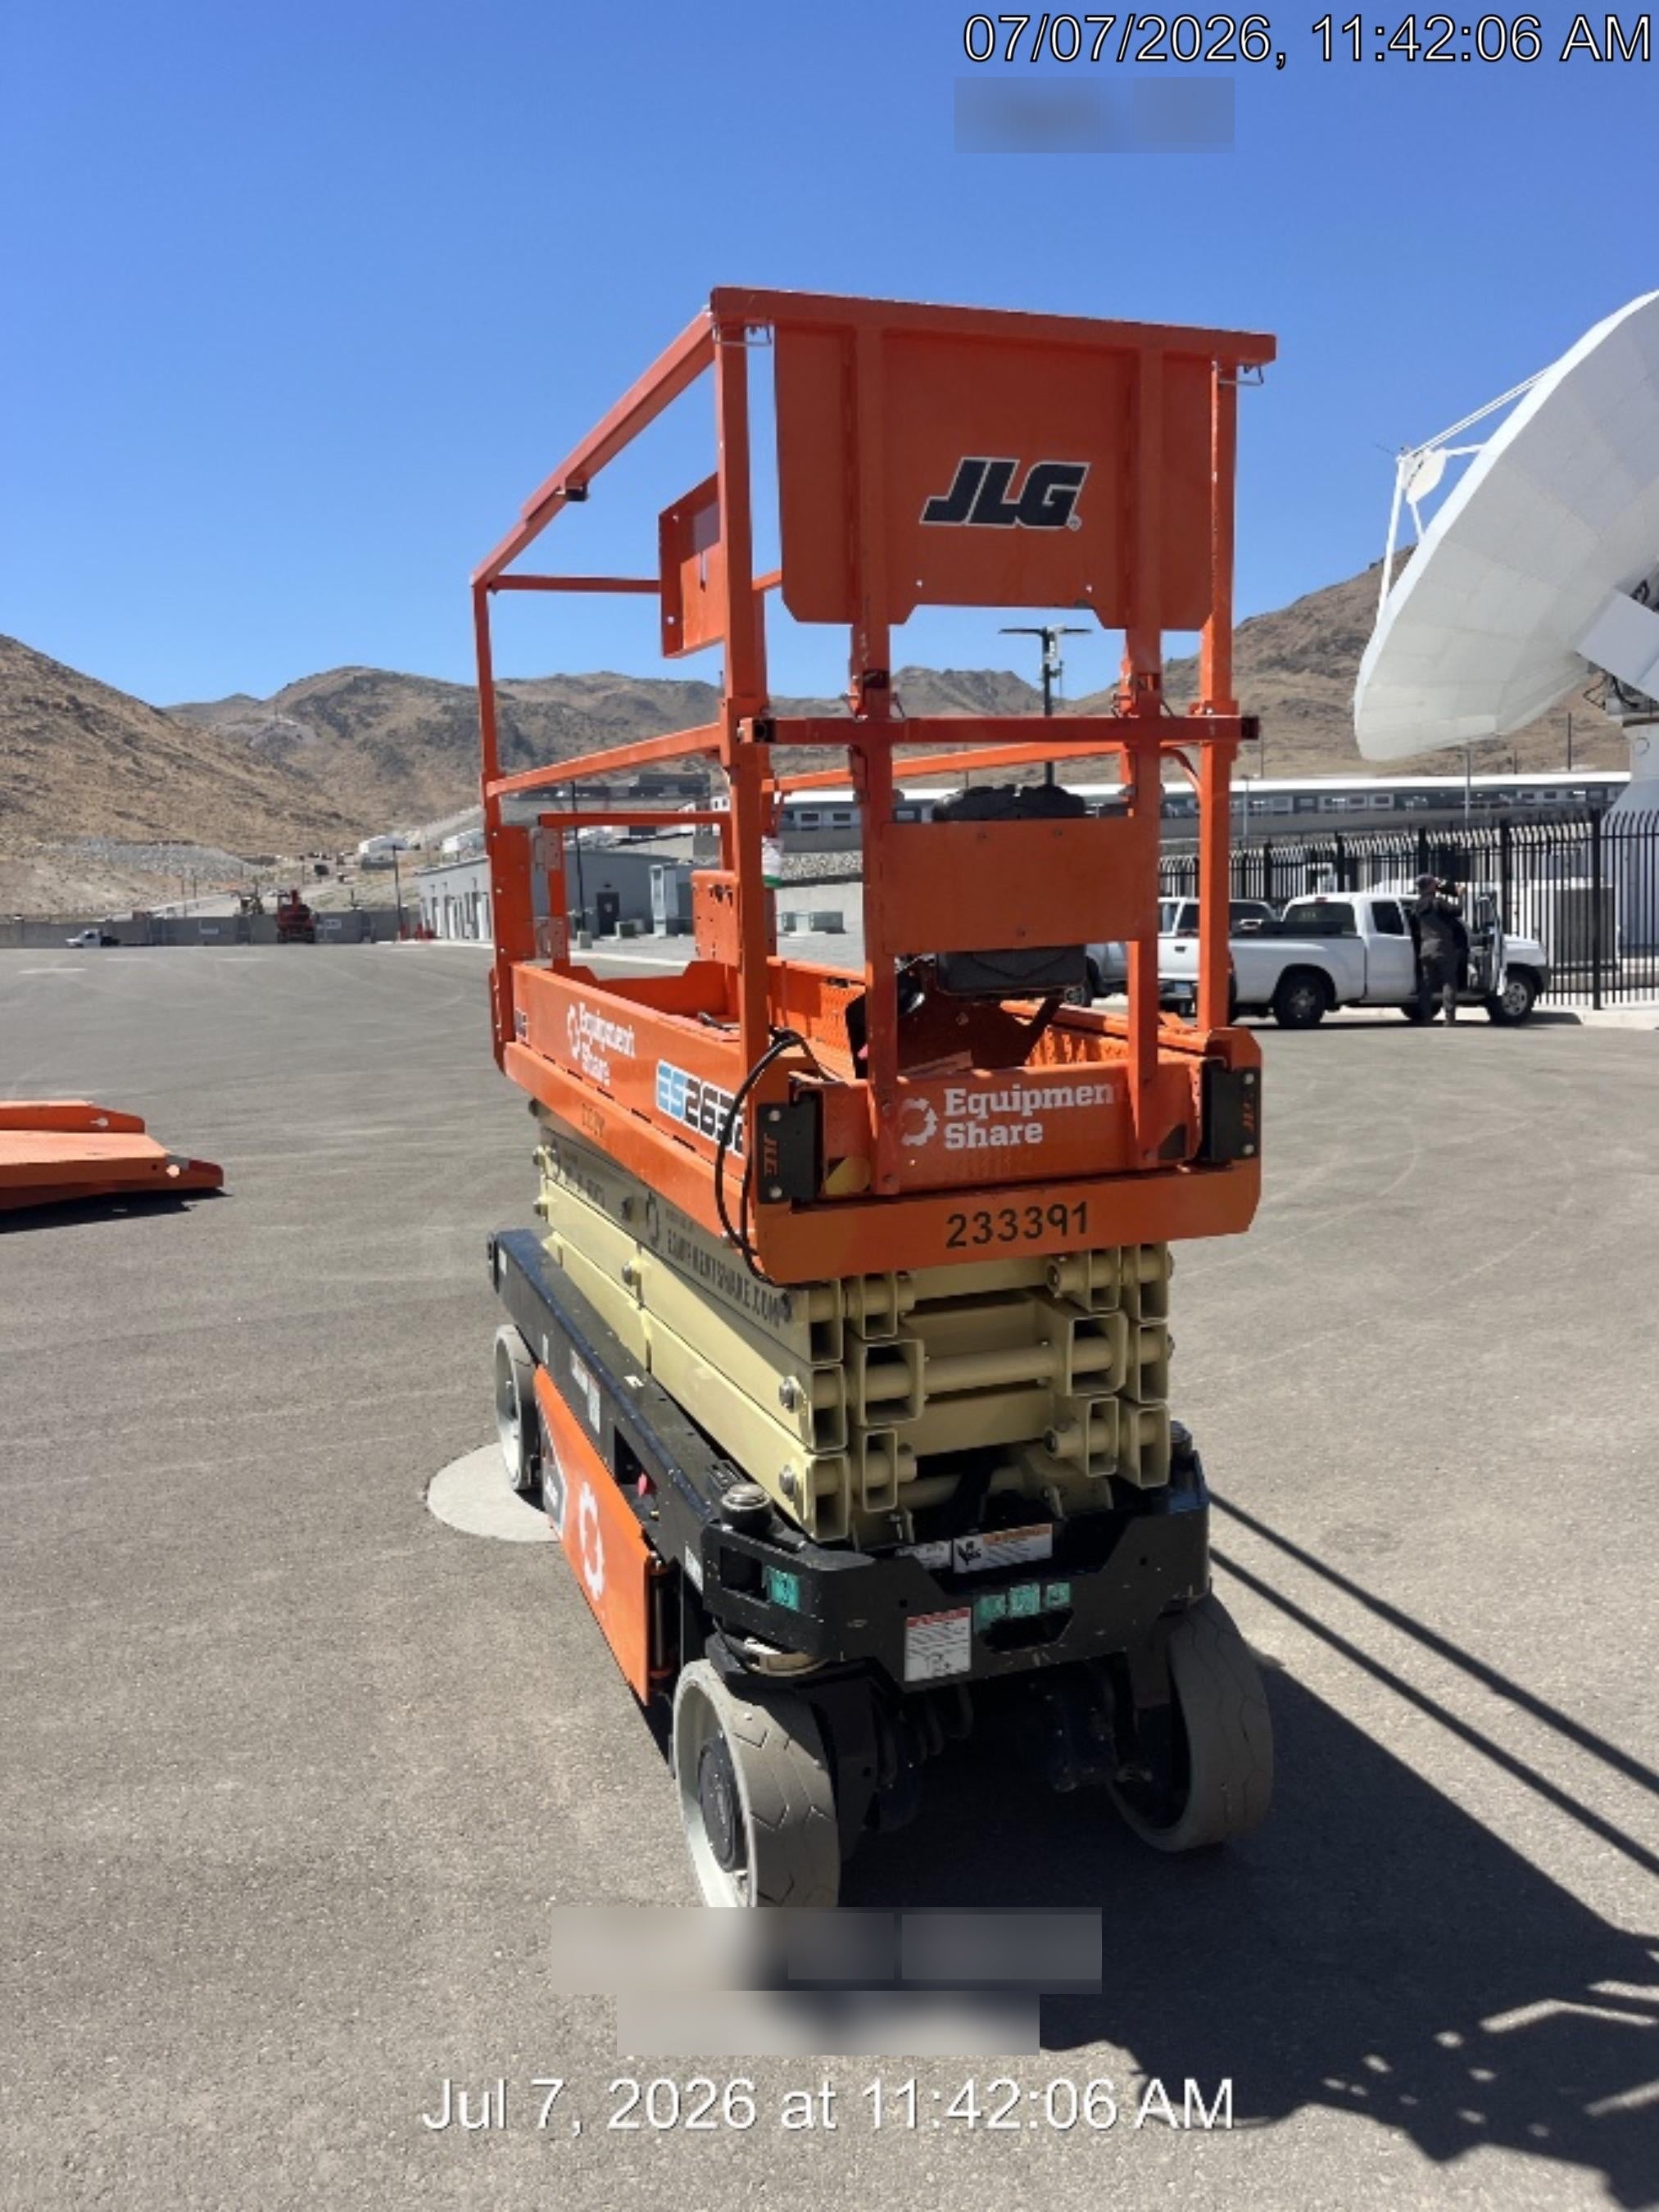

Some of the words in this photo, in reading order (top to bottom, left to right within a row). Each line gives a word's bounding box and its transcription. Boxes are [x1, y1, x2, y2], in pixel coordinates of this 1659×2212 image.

[919, 456, 1090, 530] JLG
[944, 1122, 1044, 1149] Share
[945, 1201, 1089, 1249] 233391
